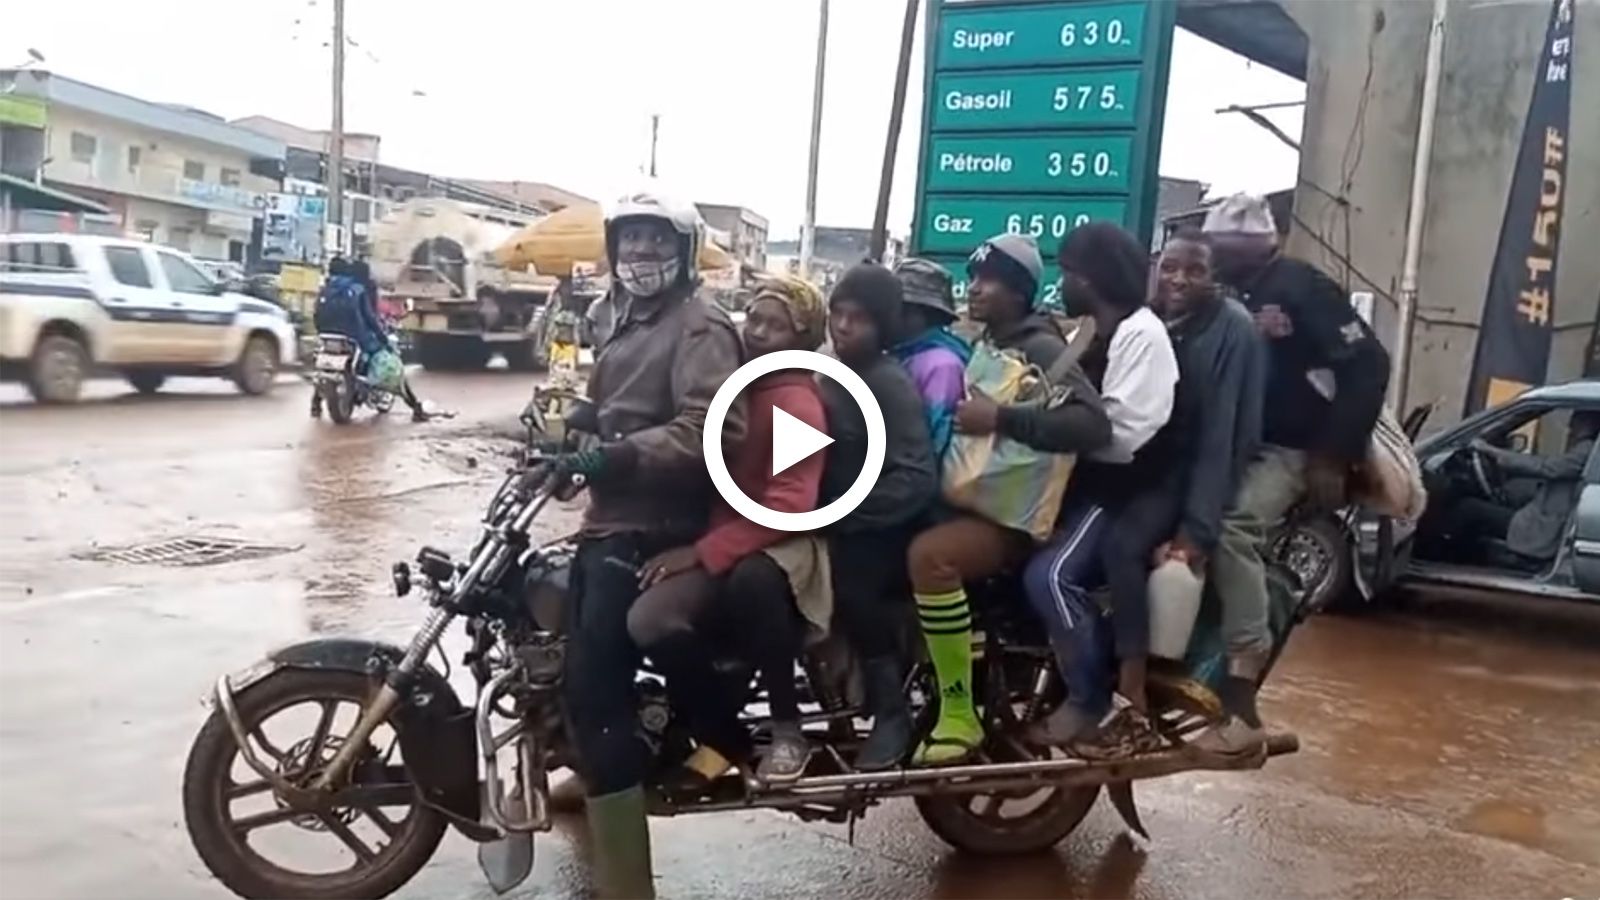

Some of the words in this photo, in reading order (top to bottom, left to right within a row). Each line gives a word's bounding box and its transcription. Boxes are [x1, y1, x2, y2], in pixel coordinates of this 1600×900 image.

[953, 29, 1014, 52] Super
[1060, 20, 1123, 47] 630
[945, 90, 1011, 110] Gasoil
[1053, 85, 1116, 110] 575
[940, 153, 1012, 173] Pétrole
[1048, 152, 1109, 176] 350
[934, 214, 973, 233] Gaz
